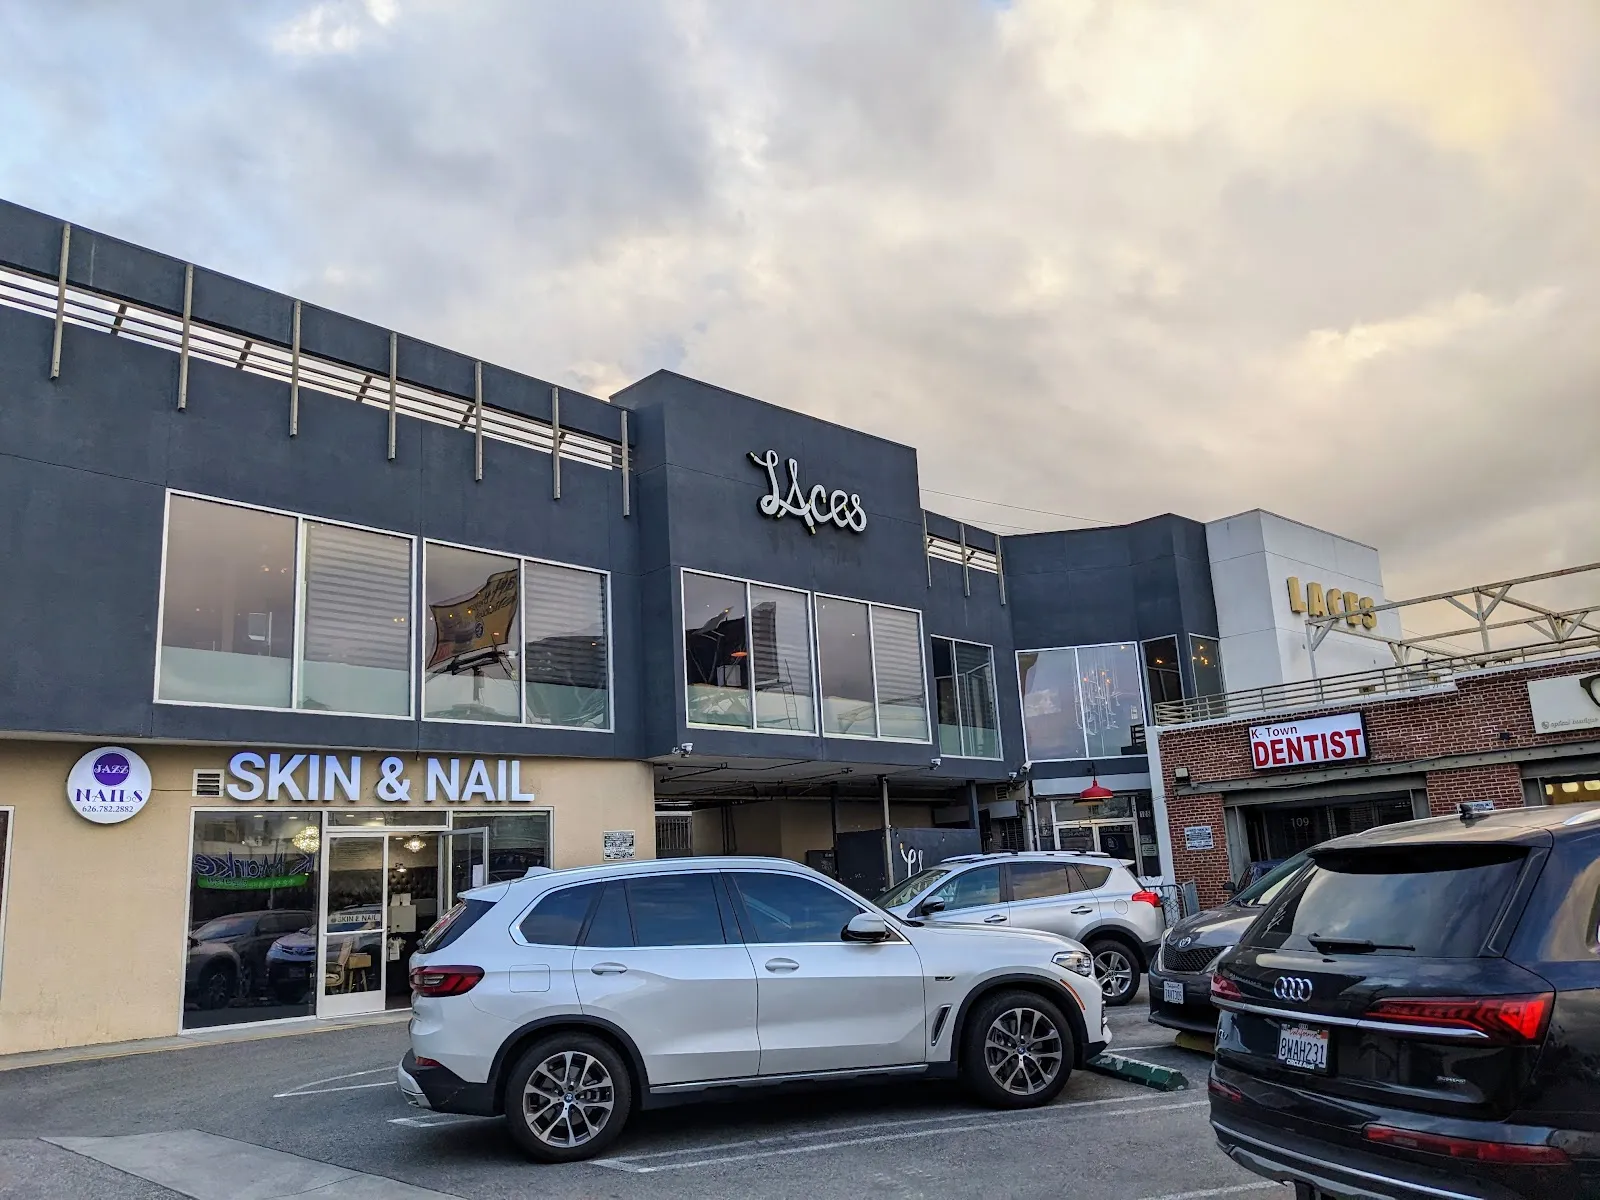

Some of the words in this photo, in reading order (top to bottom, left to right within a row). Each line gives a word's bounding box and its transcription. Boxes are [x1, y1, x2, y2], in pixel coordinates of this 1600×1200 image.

[1286, 576, 1378, 630] LACES
[1265, 726, 1298, 738] Town
[1253, 728, 1362, 767] DENTIST
[93, 764, 129, 774] JAZZ
[226, 751, 362, 802] SKIN
[376, 756, 411, 802] &
[426, 757, 536, 803] NAIL
[76, 788, 143, 803] NAILS
[82, 805, 134, 813] 626.782.2882
[1290, 816, 1310, 828] 109
[337, 915, 354, 923] SKIN
[361, 914, 378, 922] NAIL
[1280, 1037, 1325, 1065] 8WAH231
